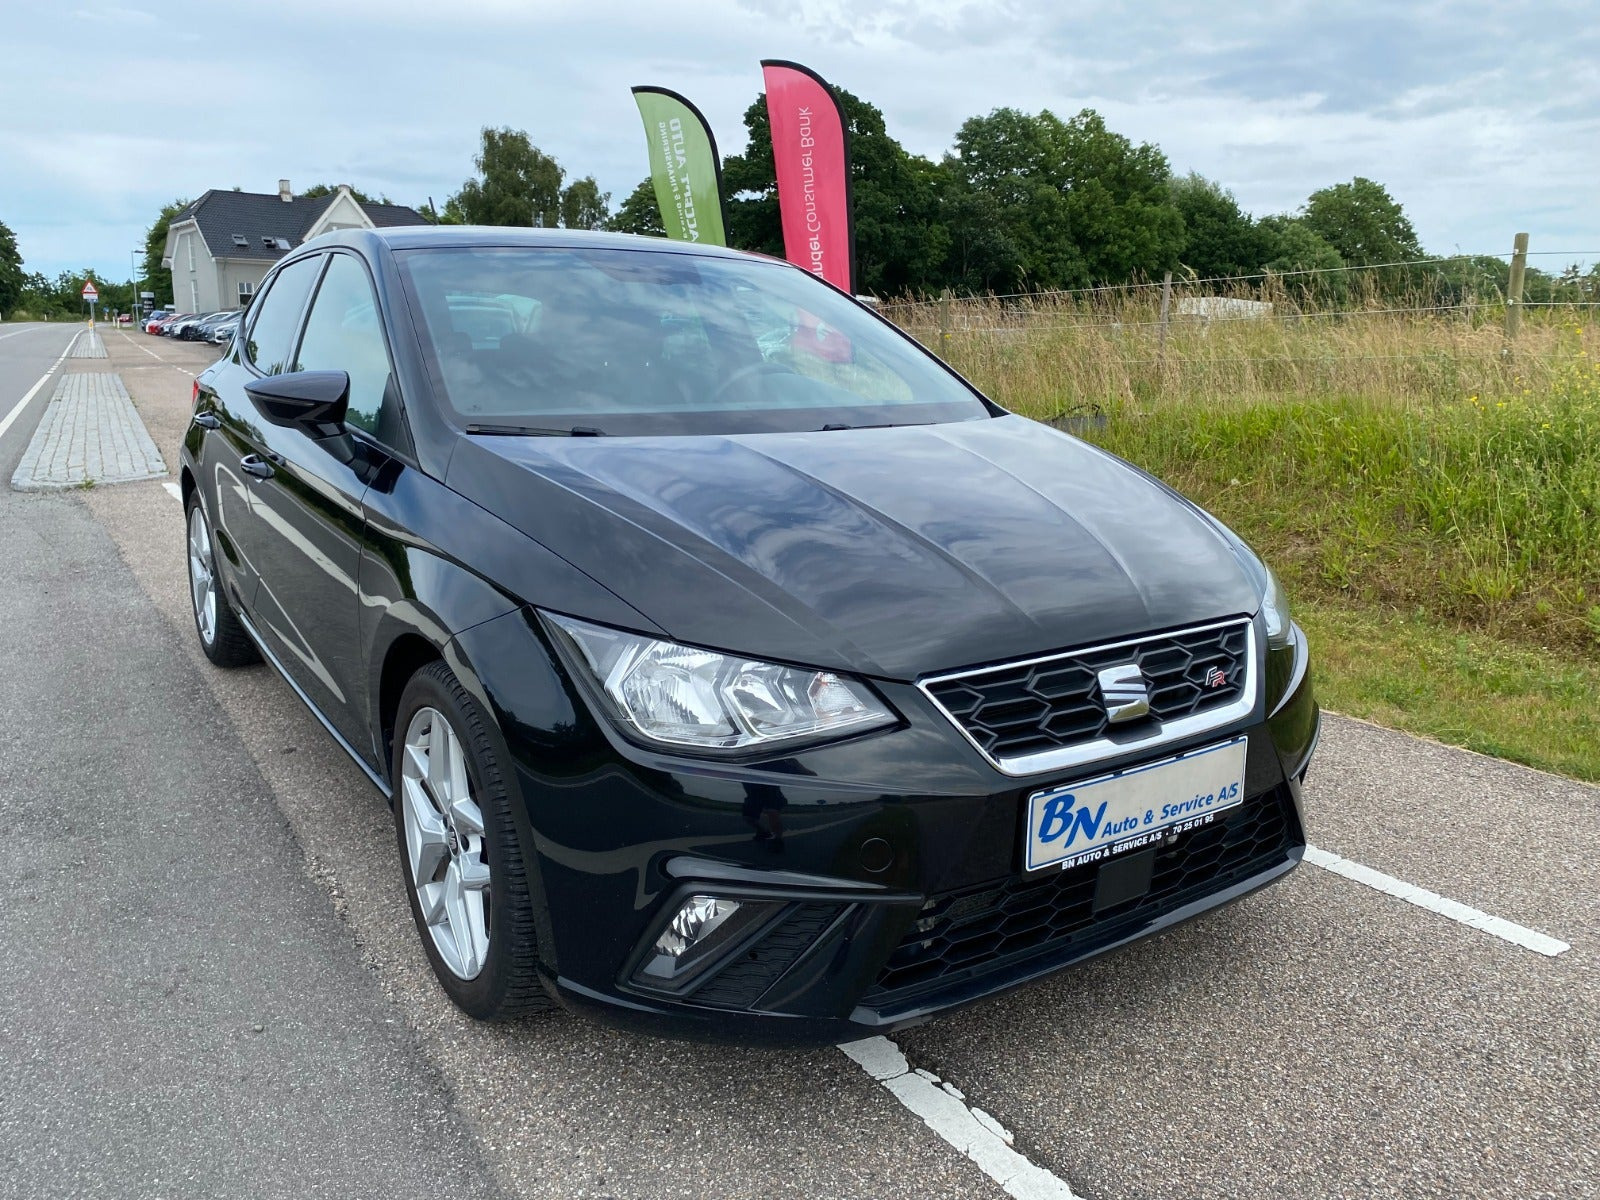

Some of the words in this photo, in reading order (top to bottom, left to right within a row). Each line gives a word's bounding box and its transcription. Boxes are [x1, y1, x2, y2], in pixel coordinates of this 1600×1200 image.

[1205, 666, 1227, 688] FR
[1037, 793, 1108, 849] BN
[1101, 815, 1138, 838] Auto
[1143, 809, 1154, 824] &
[1160, 792, 1214, 820] Service
[1217, 782, 1239, 802] A/S
[1061, 859, 1075, 870] BN
[1076, 851, 1102, 867] AUTO
[1103, 849, 1110, 857] &
[1112, 836, 1148, 854] SERVICE
[1148, 831, 1162, 842] A/S
[1172, 826, 1182, 835] 70
[1183, 822, 1193, 831] 25
[1194, 818, 1203, 828] 01
[1204, 814, 1214, 824] 95
